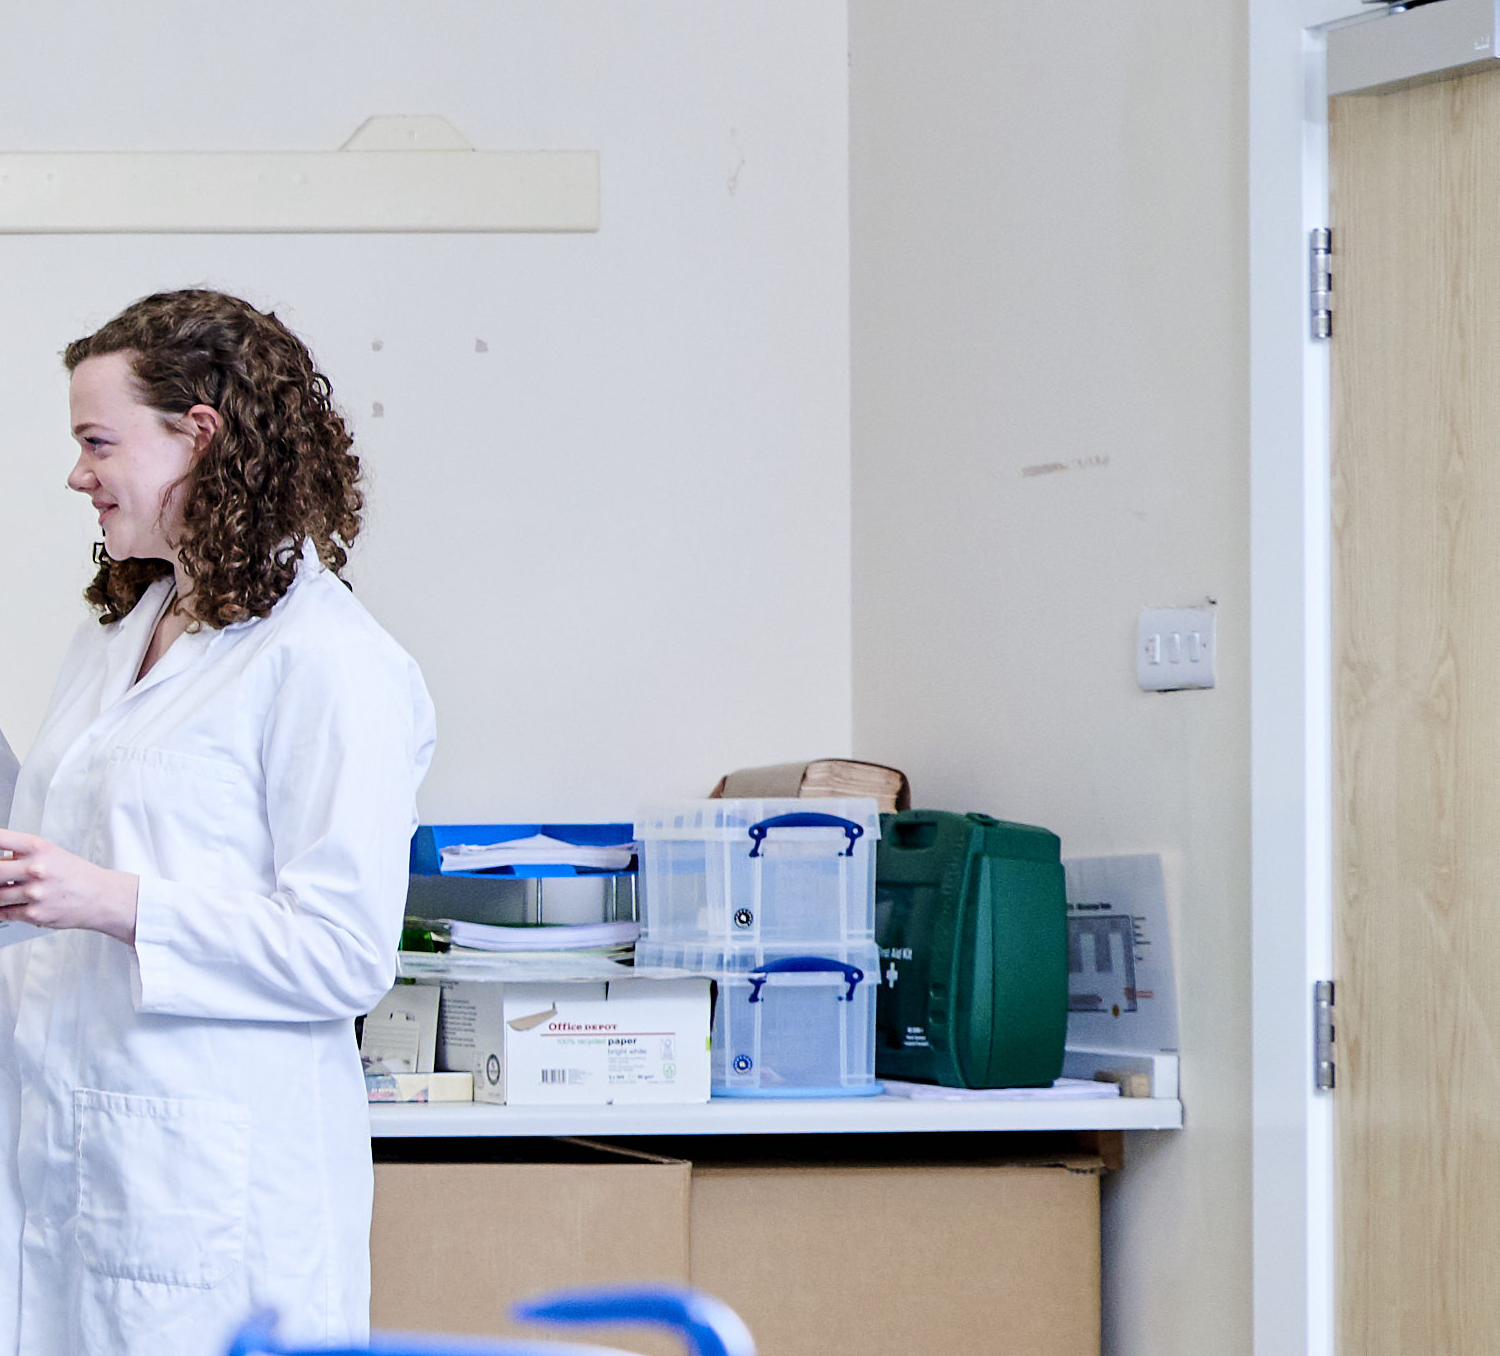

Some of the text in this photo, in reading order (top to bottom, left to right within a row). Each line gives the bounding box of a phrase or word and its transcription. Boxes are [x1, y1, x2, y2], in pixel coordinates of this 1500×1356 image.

[548, 1022, 617, 1032] Office DEPOT
[608, 1038, 637, 1047] paper
